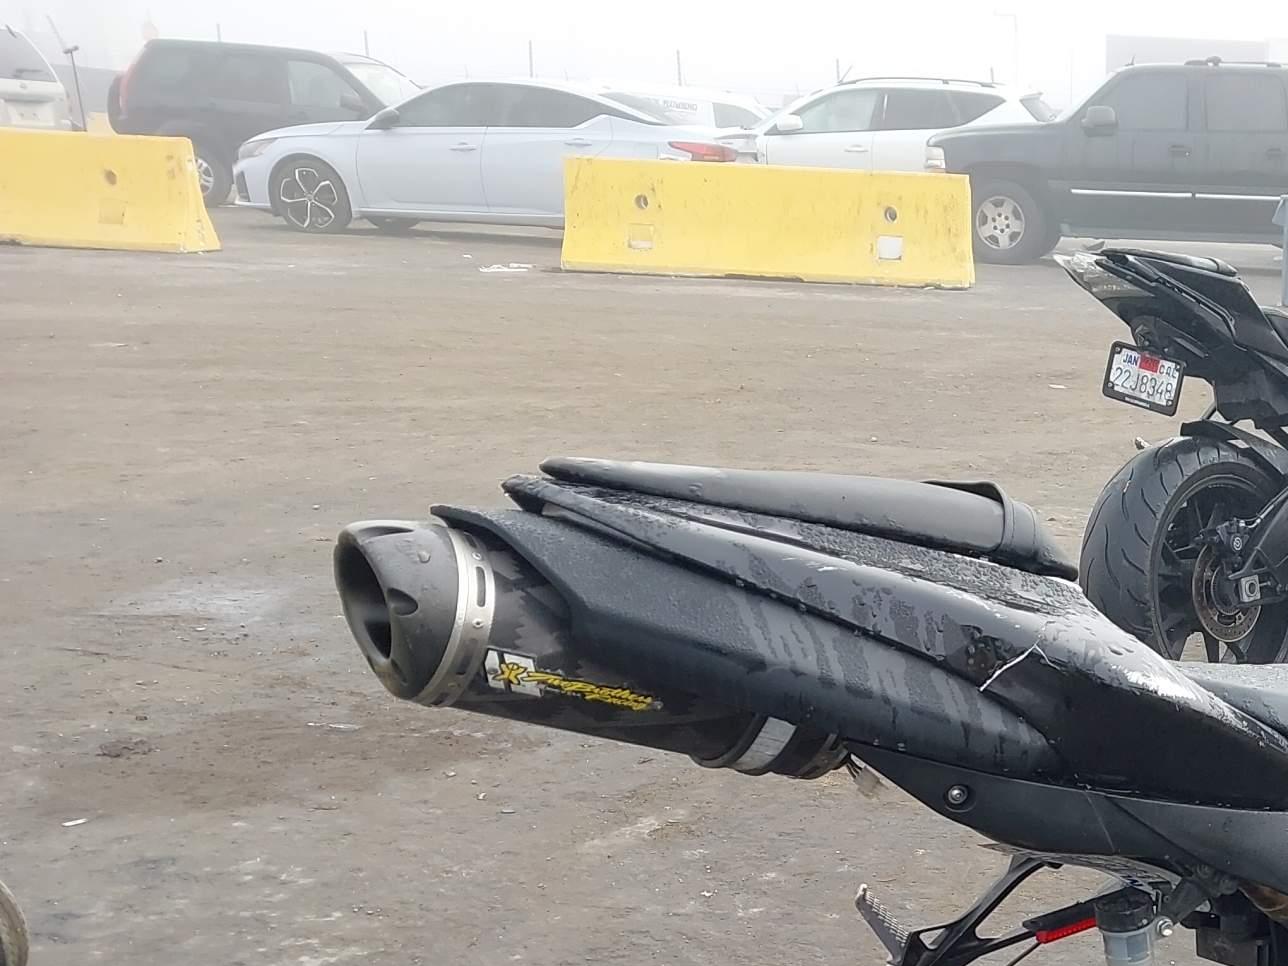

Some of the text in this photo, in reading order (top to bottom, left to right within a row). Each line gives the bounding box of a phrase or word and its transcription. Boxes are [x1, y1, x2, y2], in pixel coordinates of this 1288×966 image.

[1122, 354, 1140, 367] JAN
[1159, 364, 1177, 379] CAL
[1114, 367, 1173, 401] 22J8348
